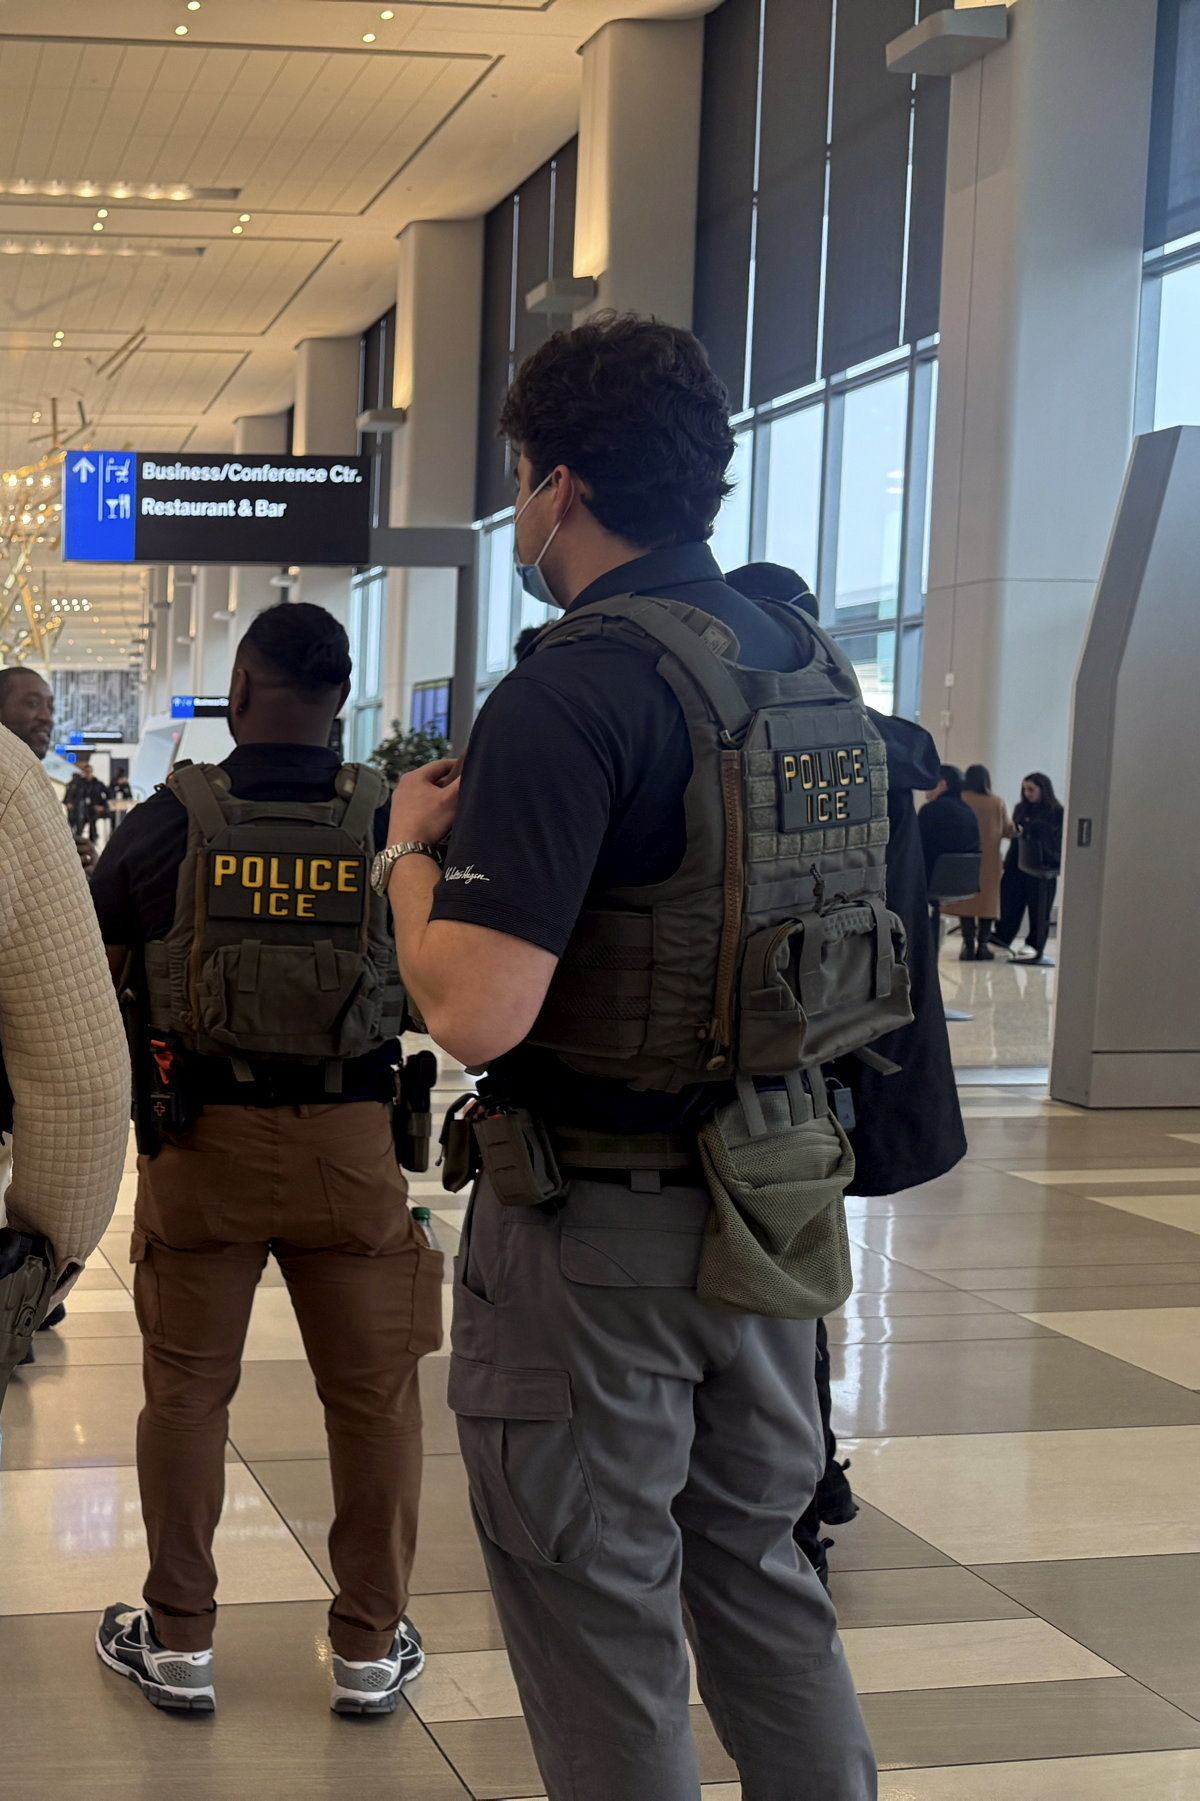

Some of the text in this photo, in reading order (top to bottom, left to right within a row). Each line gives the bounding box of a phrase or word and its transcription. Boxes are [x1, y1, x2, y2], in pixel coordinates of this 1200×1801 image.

[142, 461, 363, 483] Business/Conference Ctr.
[141, 497, 288, 518] Restaurant & Bar
[783, 749, 867, 792] POLICE
[806, 791, 849, 823] ICE
[214, 854, 361, 892] POLICE
[253, 891, 317, 918] ICE
